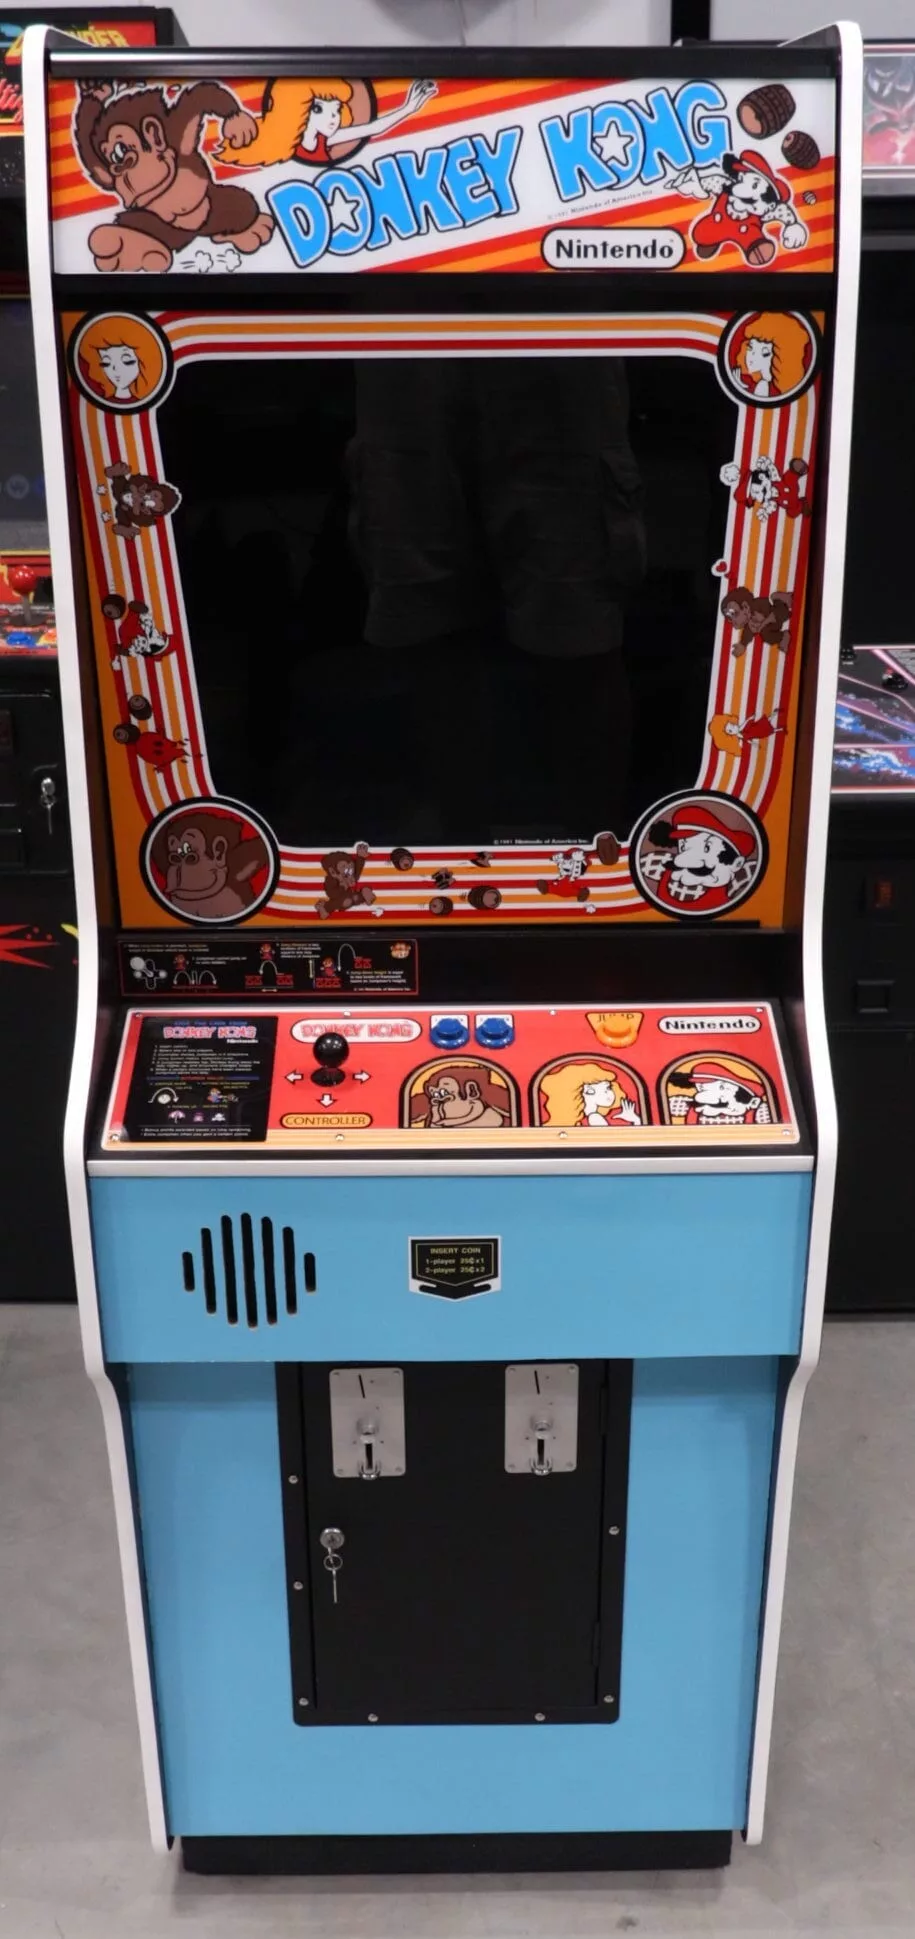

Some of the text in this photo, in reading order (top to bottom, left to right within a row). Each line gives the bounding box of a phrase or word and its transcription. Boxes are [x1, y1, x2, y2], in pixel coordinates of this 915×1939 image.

[265, 80, 732, 269] DONKEY KONG
[556, 239, 674, 259] Nintendo
[367, 1023, 414, 1038] KONG
[664, 1017, 756, 1031] Nintendo
[285, 1115, 366, 1126] CONTROLLER
